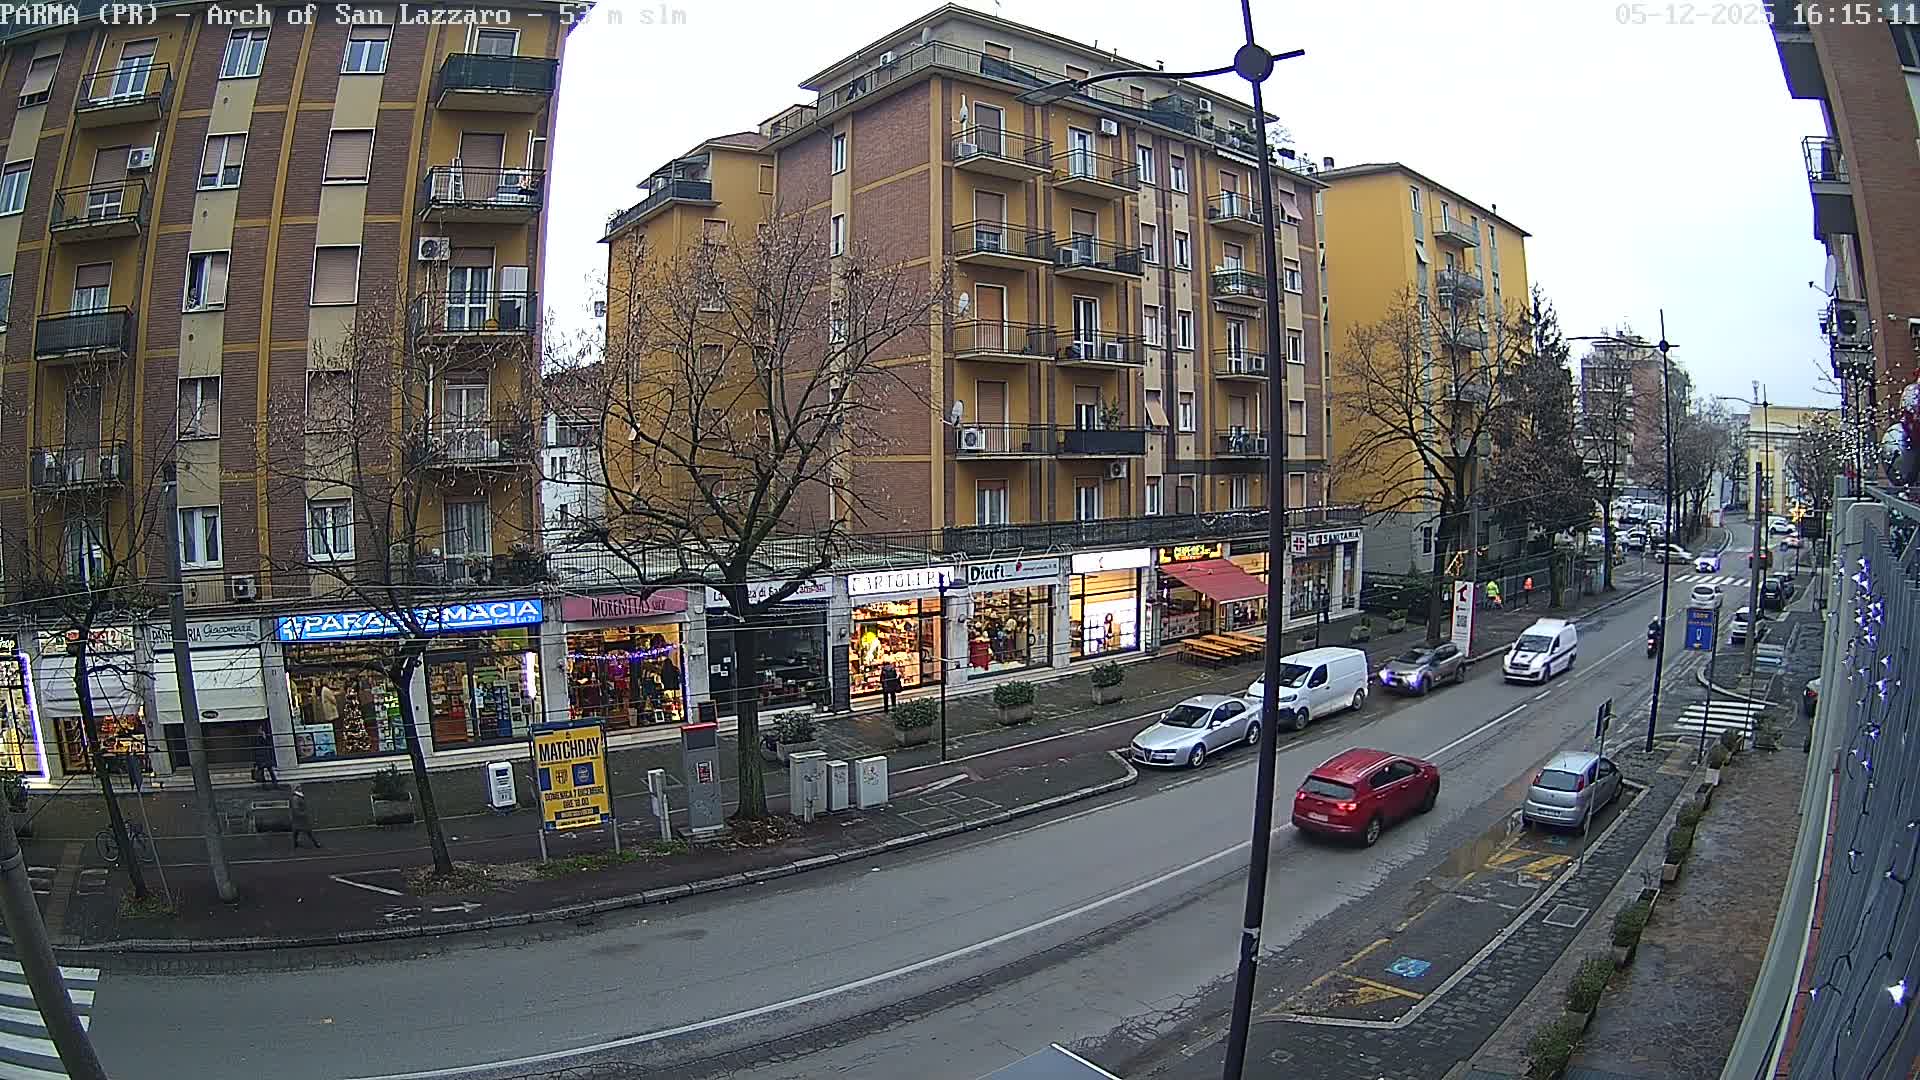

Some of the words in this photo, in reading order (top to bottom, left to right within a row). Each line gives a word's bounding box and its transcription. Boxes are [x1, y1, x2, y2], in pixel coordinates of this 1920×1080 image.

[306, 602, 539, 632] PARAFRMACIA
[152, 628, 201, 643] PANERIA
[539, 737, 600, 762] MATCHDAY
